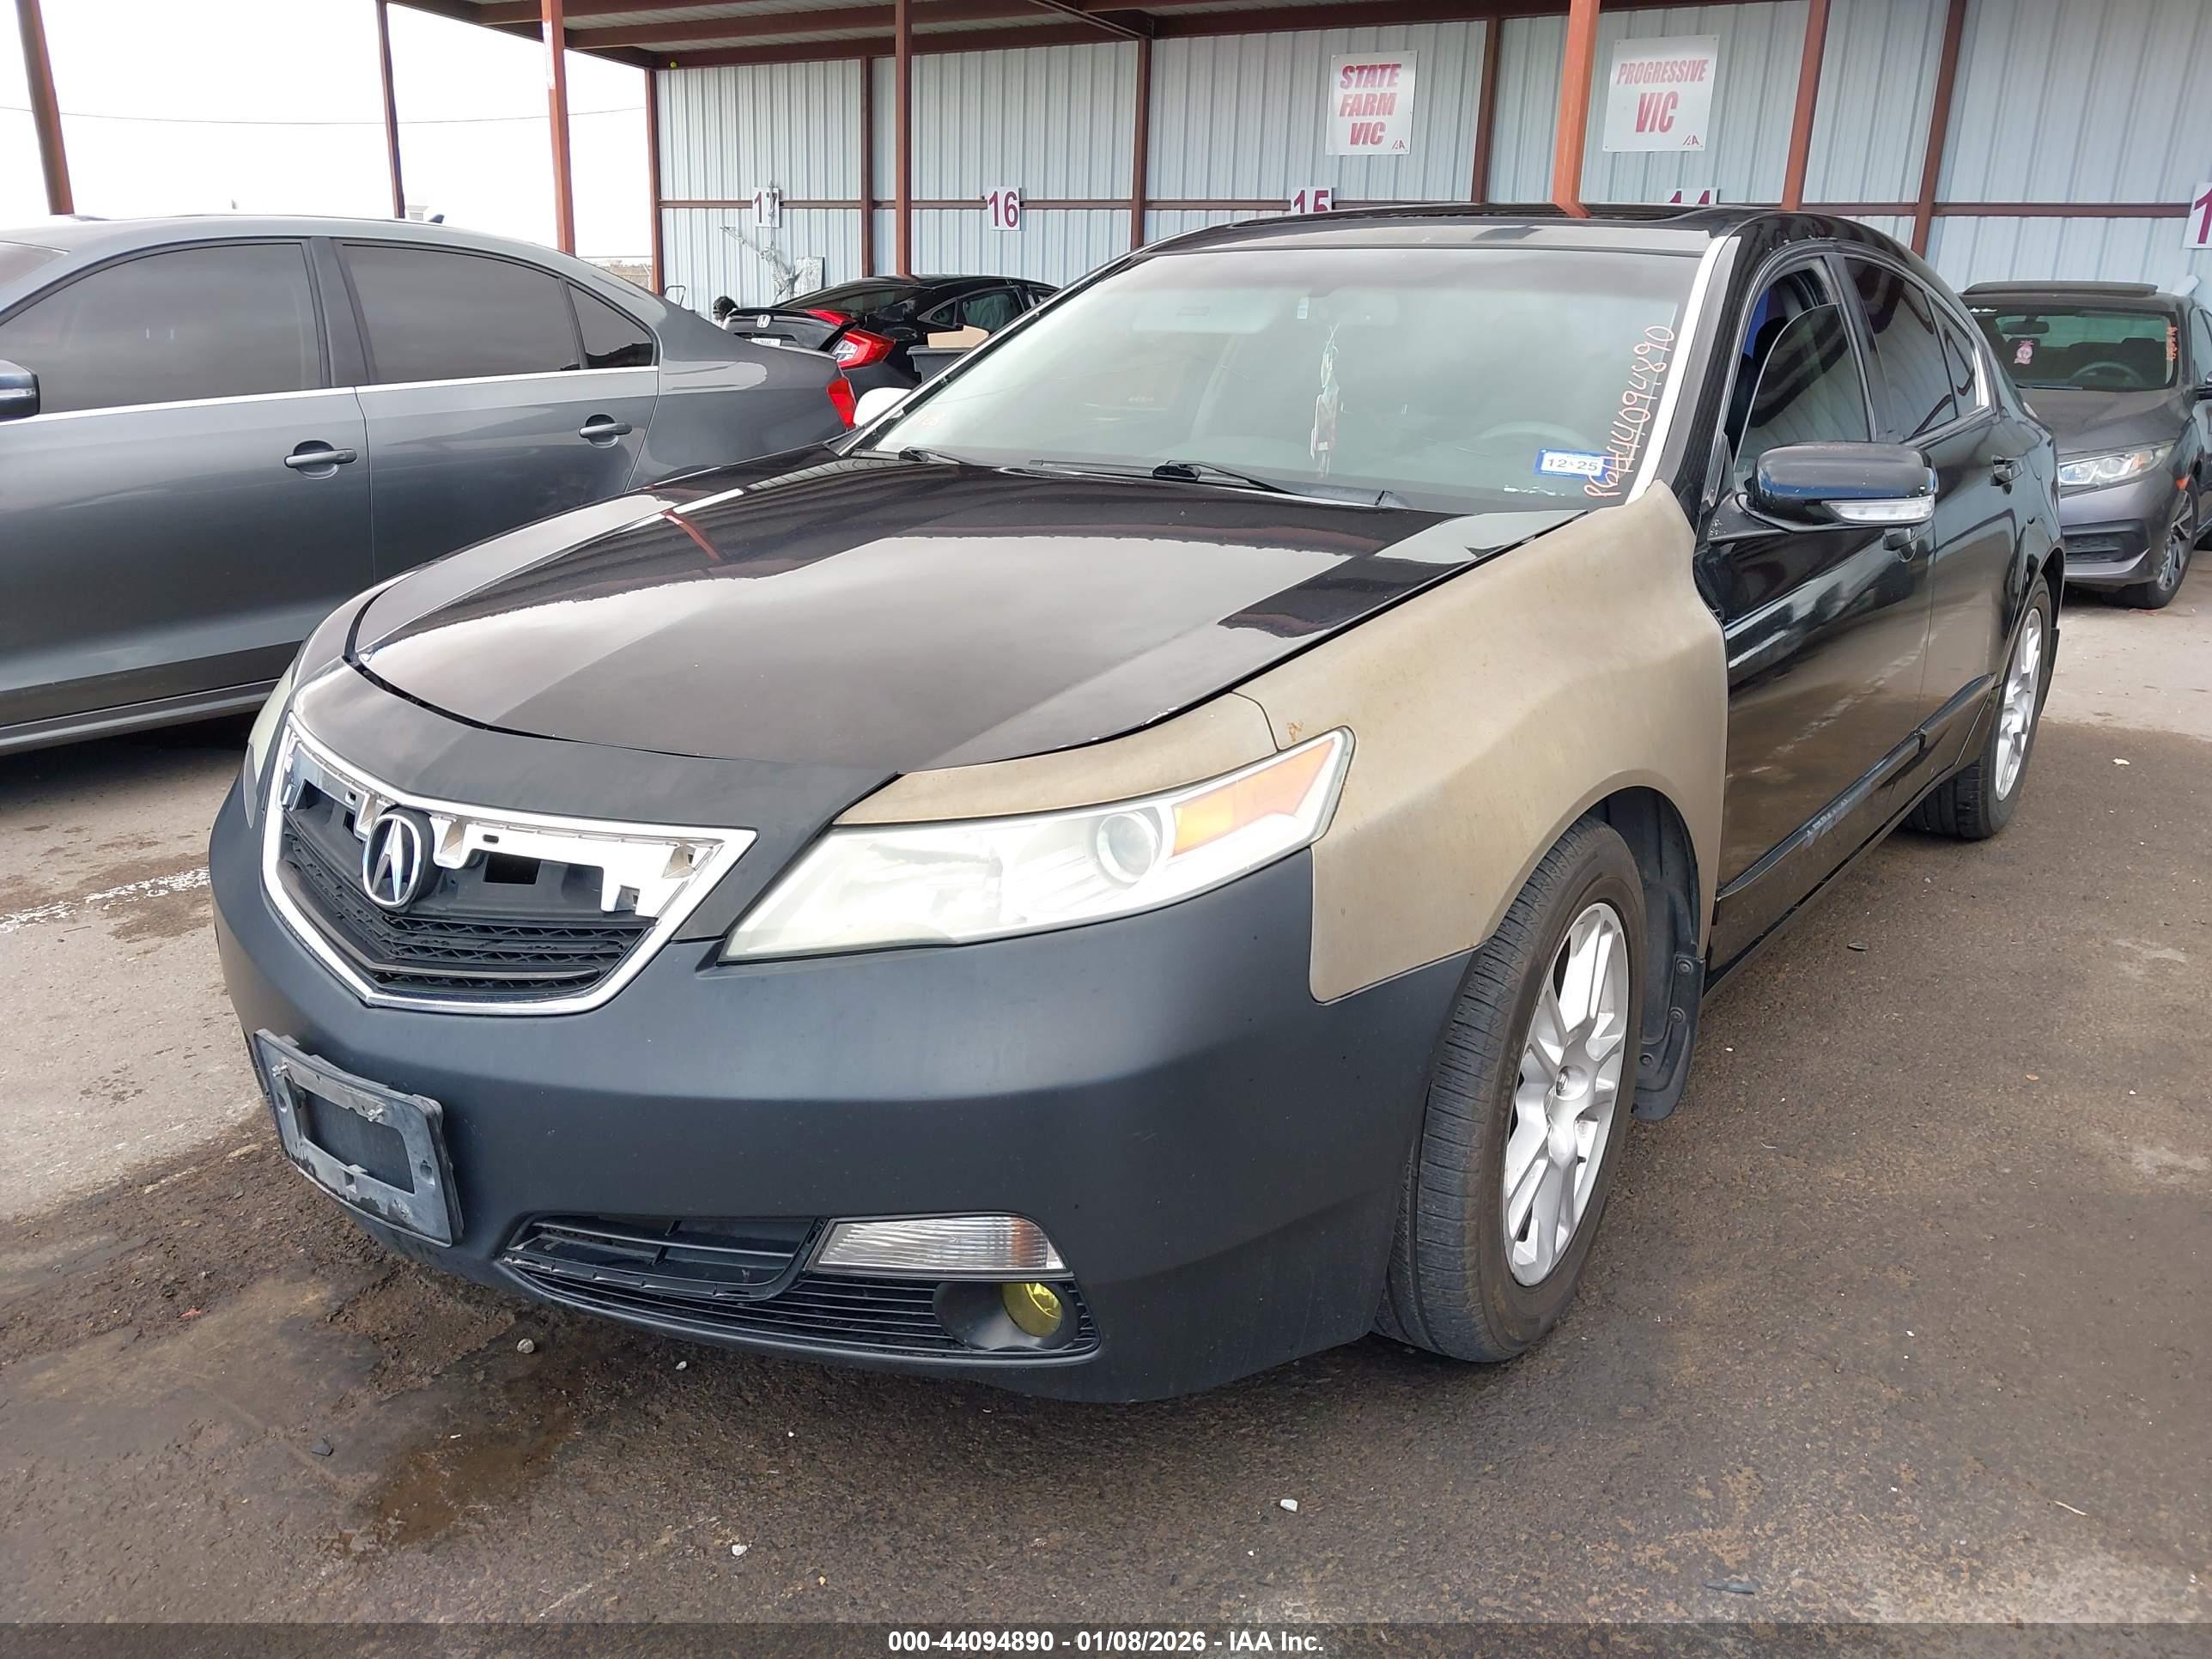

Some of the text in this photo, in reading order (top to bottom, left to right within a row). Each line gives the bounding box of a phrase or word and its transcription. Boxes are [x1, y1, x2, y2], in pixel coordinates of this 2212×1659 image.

[1340, 64, 1401, 89] STATE
[1616, 59, 1709, 84] PROGRESSIVE
[1340, 93, 1398, 117] FARM
[1635, 91, 1679, 132] VIC
[1350, 122, 1386, 146] VIC
[988, 191, 1018, 228] 16
[1294, 190, 1329, 214] 15
